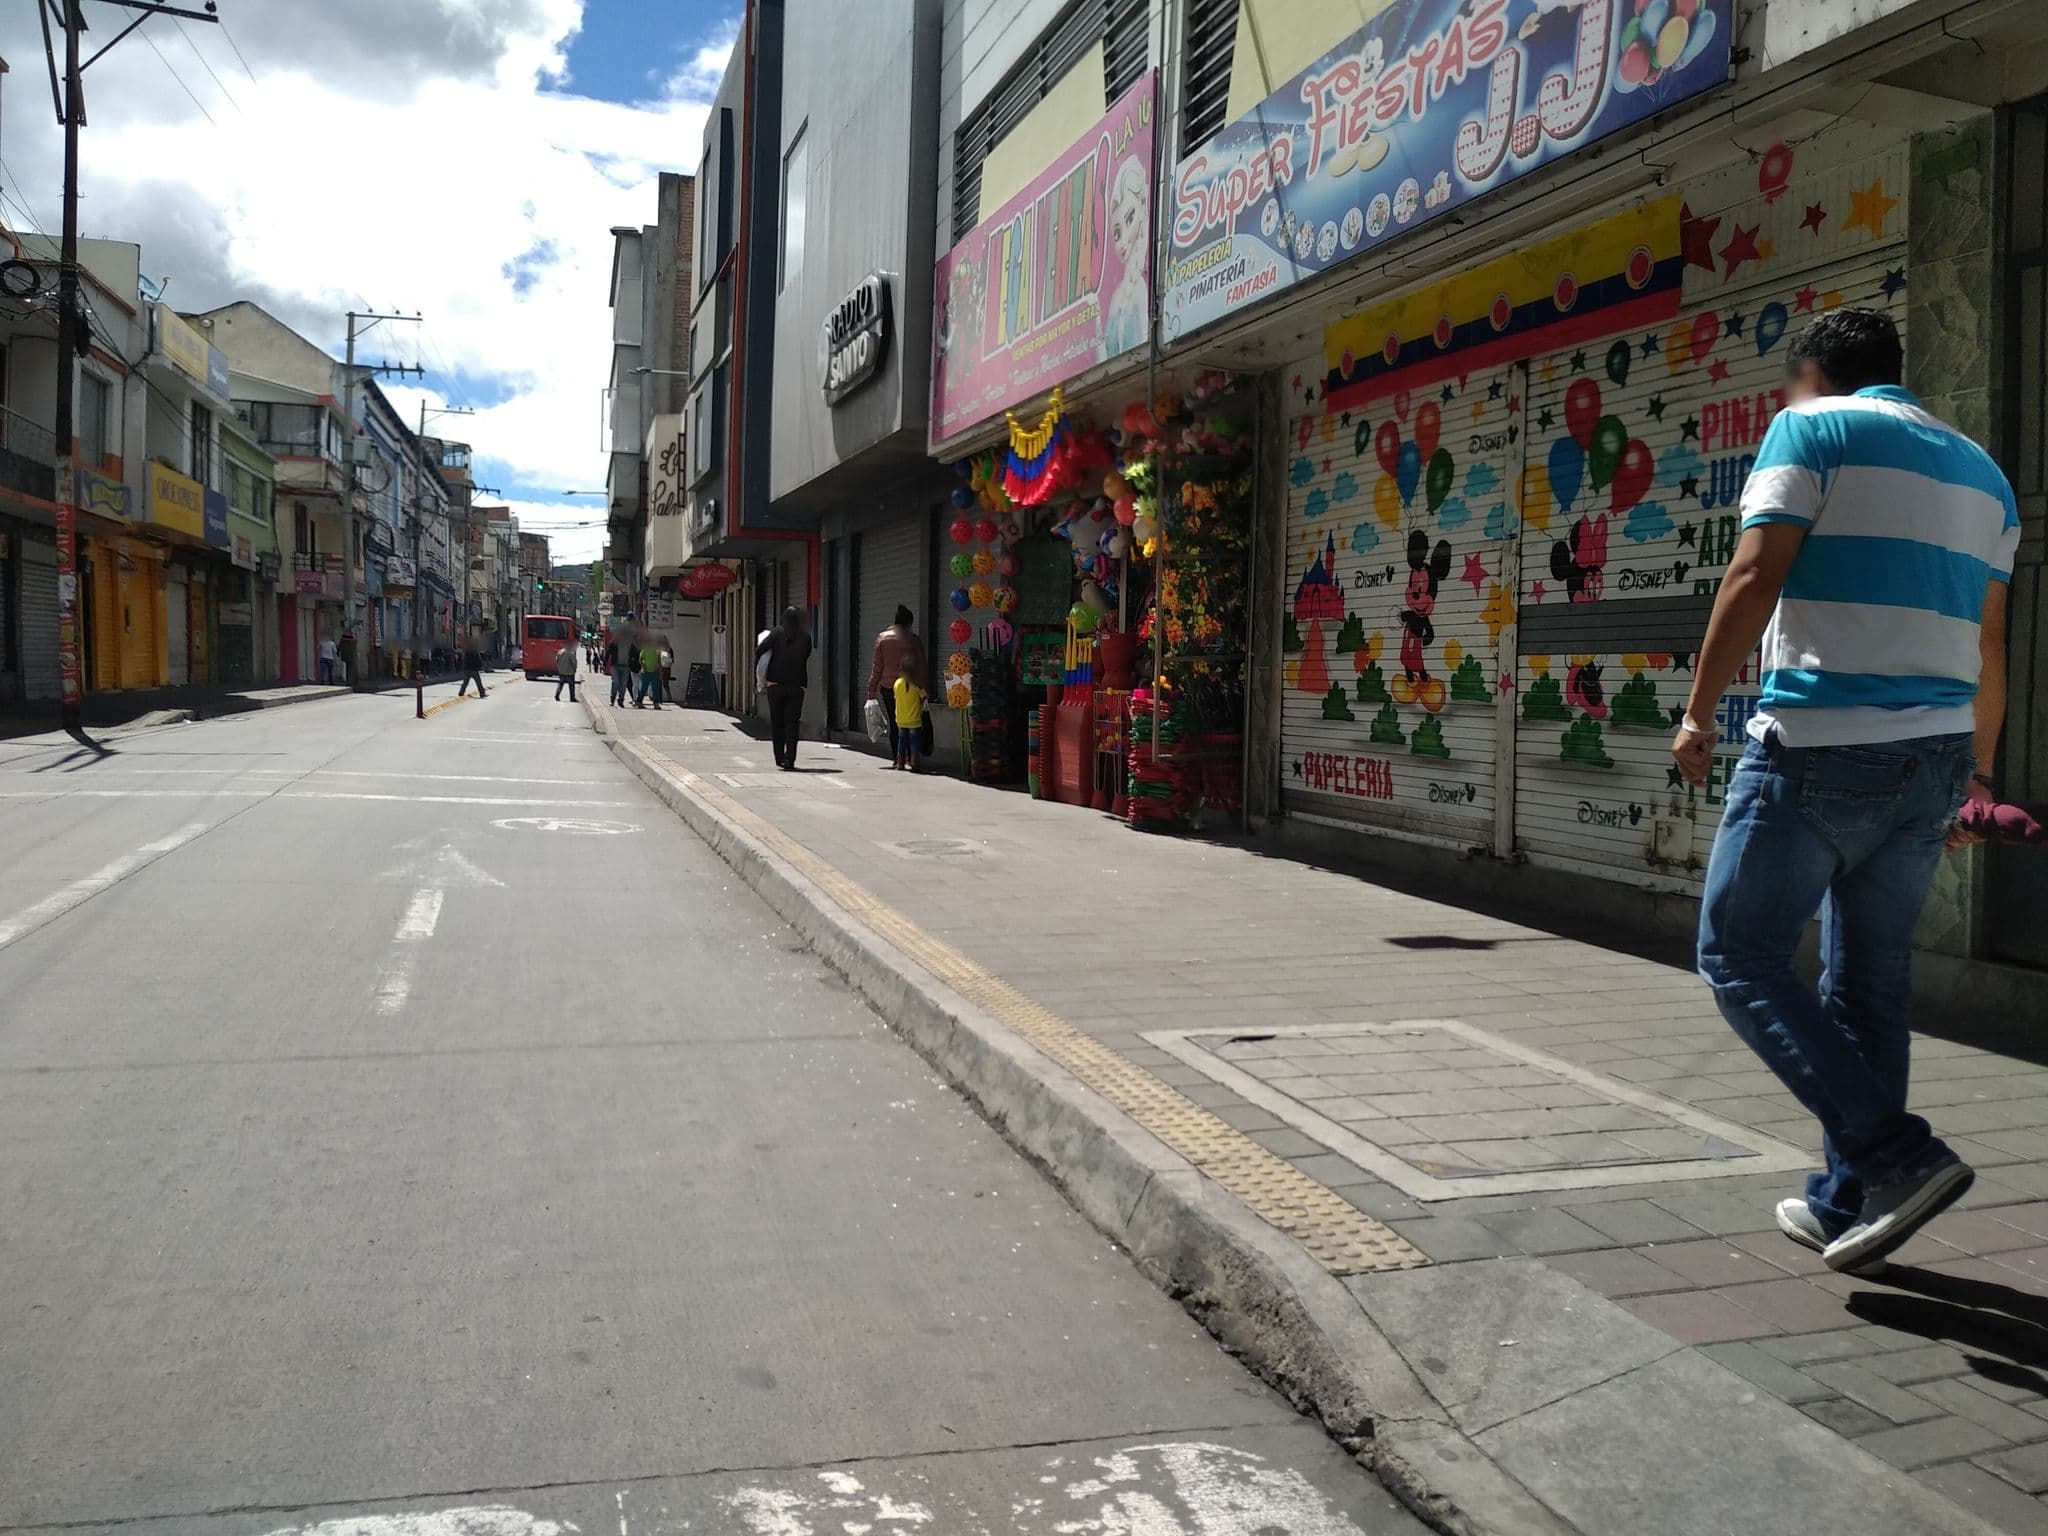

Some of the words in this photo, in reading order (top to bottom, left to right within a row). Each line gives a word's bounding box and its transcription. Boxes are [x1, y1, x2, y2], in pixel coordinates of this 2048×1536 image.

[1113, 117, 1134, 160] LA
[1179, 237, 1232, 282] PAPELERIA
[1189, 253, 1246, 304] PIÑATERÍA
[1226, 261, 1277, 306] FANTASÍA
[829, 283, 872, 343] RADIO
[830, 331, 870, 389] SANYO
[1303, 751, 1393, 800] PAPELERIA
